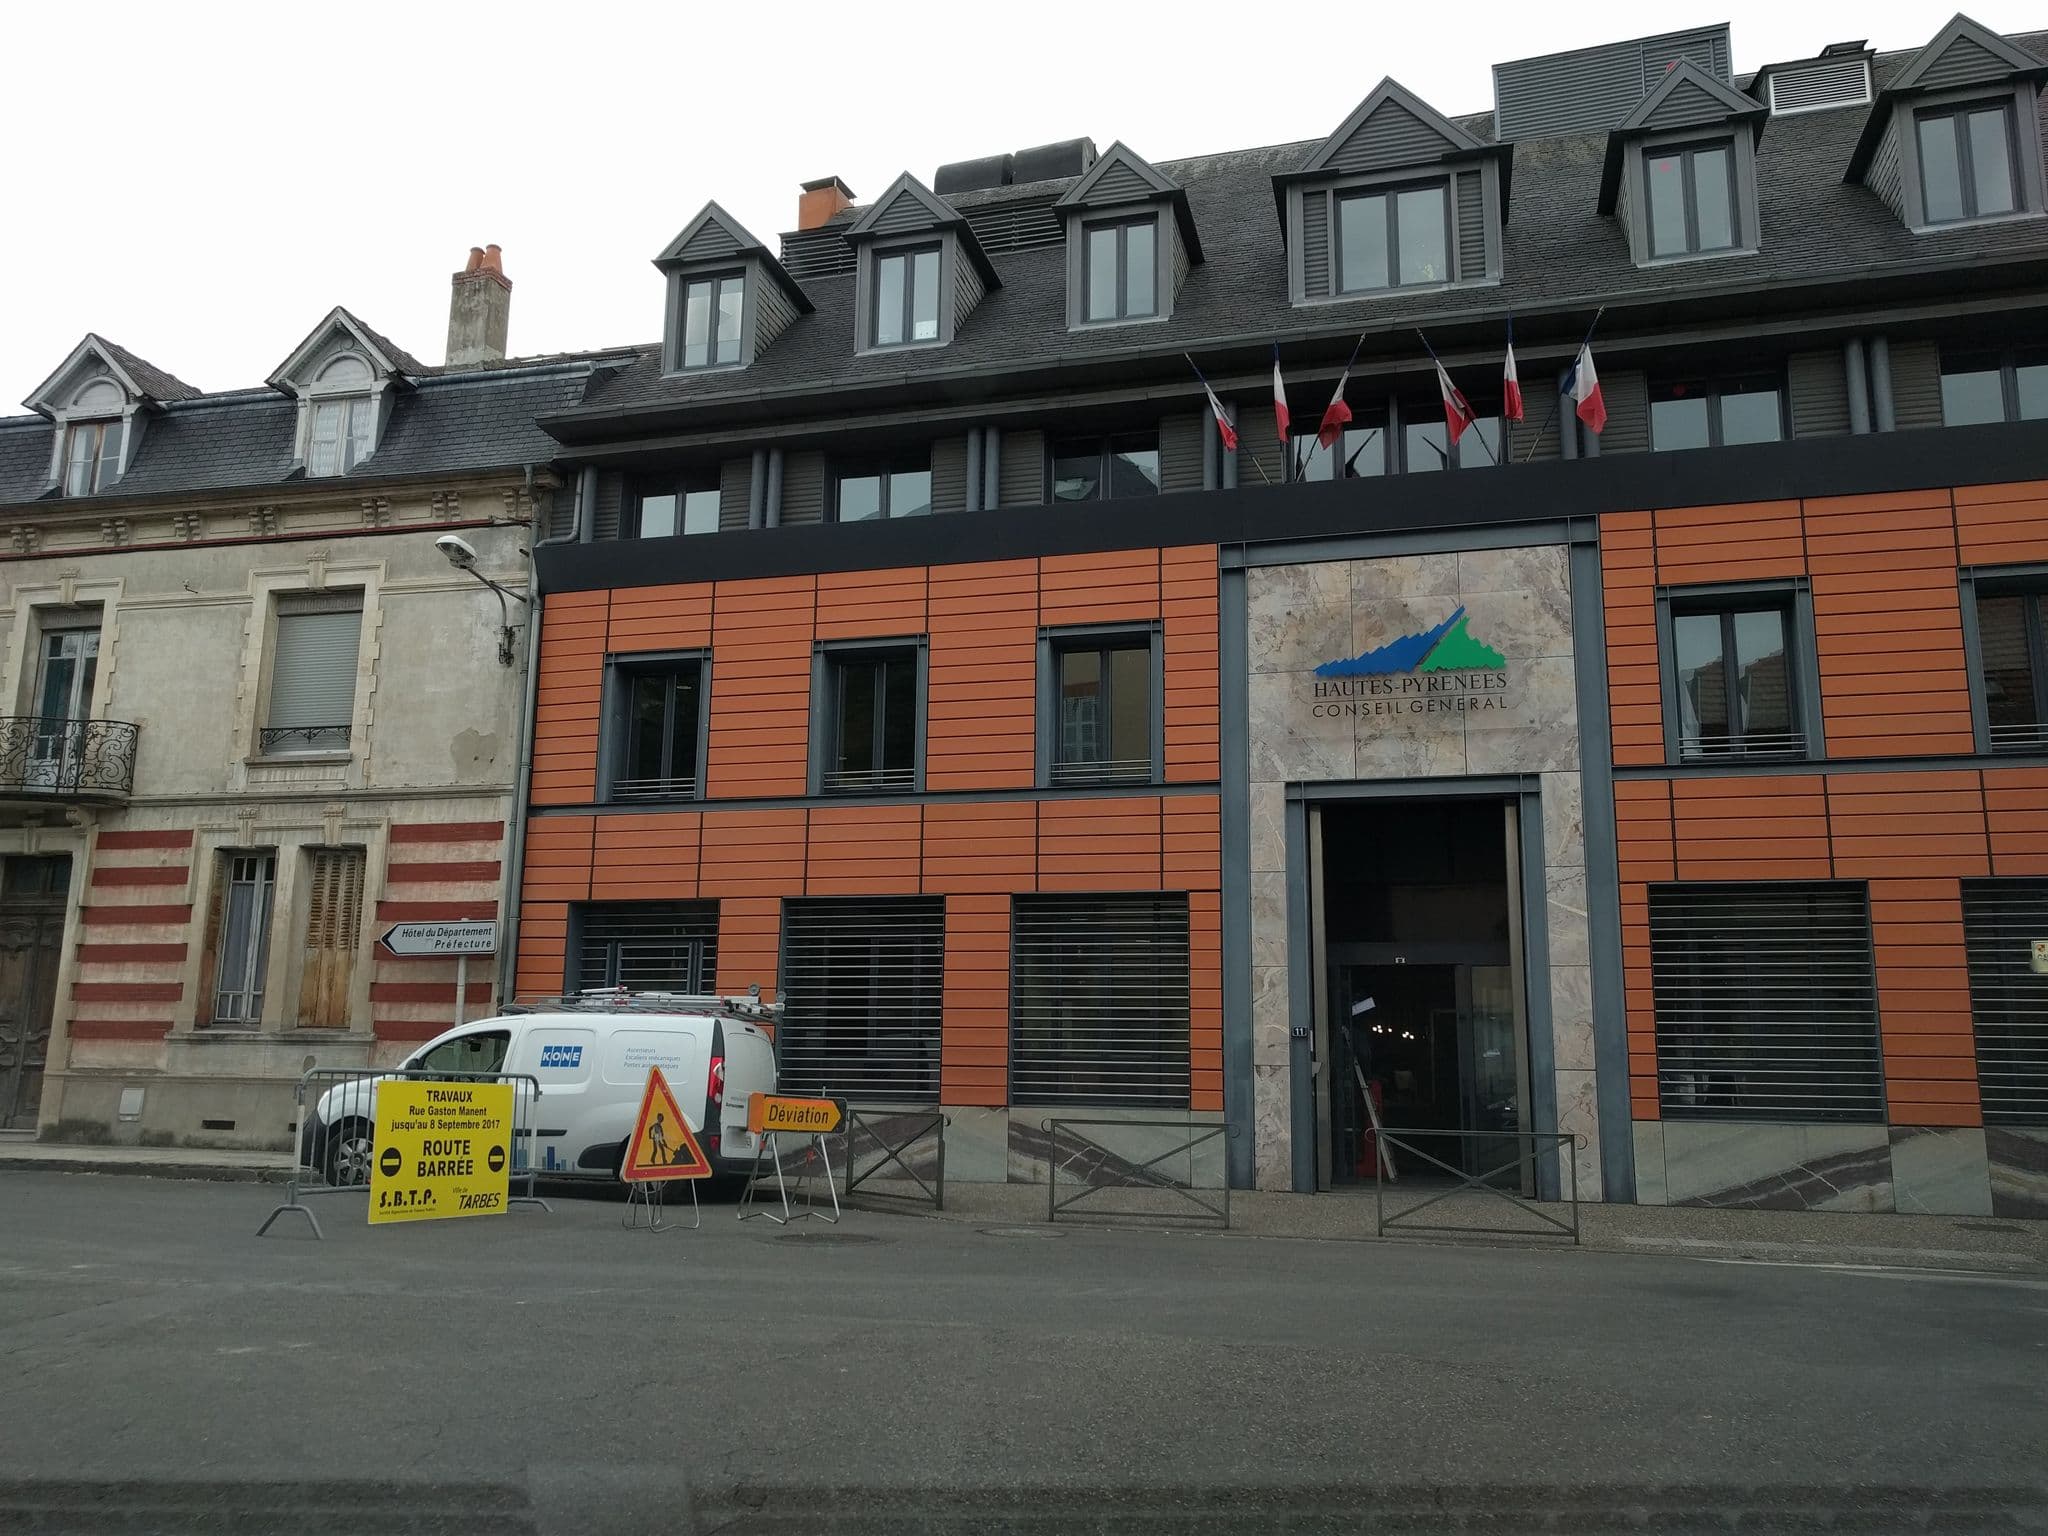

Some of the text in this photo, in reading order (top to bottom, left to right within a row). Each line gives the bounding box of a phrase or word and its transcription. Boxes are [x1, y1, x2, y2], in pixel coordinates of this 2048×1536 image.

[1314, 672, 1507, 698] HAUTES-PYRENEES
[1312, 696, 1507, 718] CONSEIL GENERAL
[402, 927, 492, 938] Hôtel du Département
[434, 939, 492, 949] Préfecture
[427, 1090, 473, 1102] TRAVAUX
[409, 1105, 487, 1116] Rue Gaston Manent
[768, 1104, 829, 1124] Déviation
[391, 1119, 500, 1132] jusqu'au 8 Septembre 2017
[423, 1140, 471, 1156] ROUTE
[417, 1156, 474, 1177] BARRÉE
[380, 1189, 437, 1208] S.B.T.P.
[459, 1193, 501, 1210] TARBES
